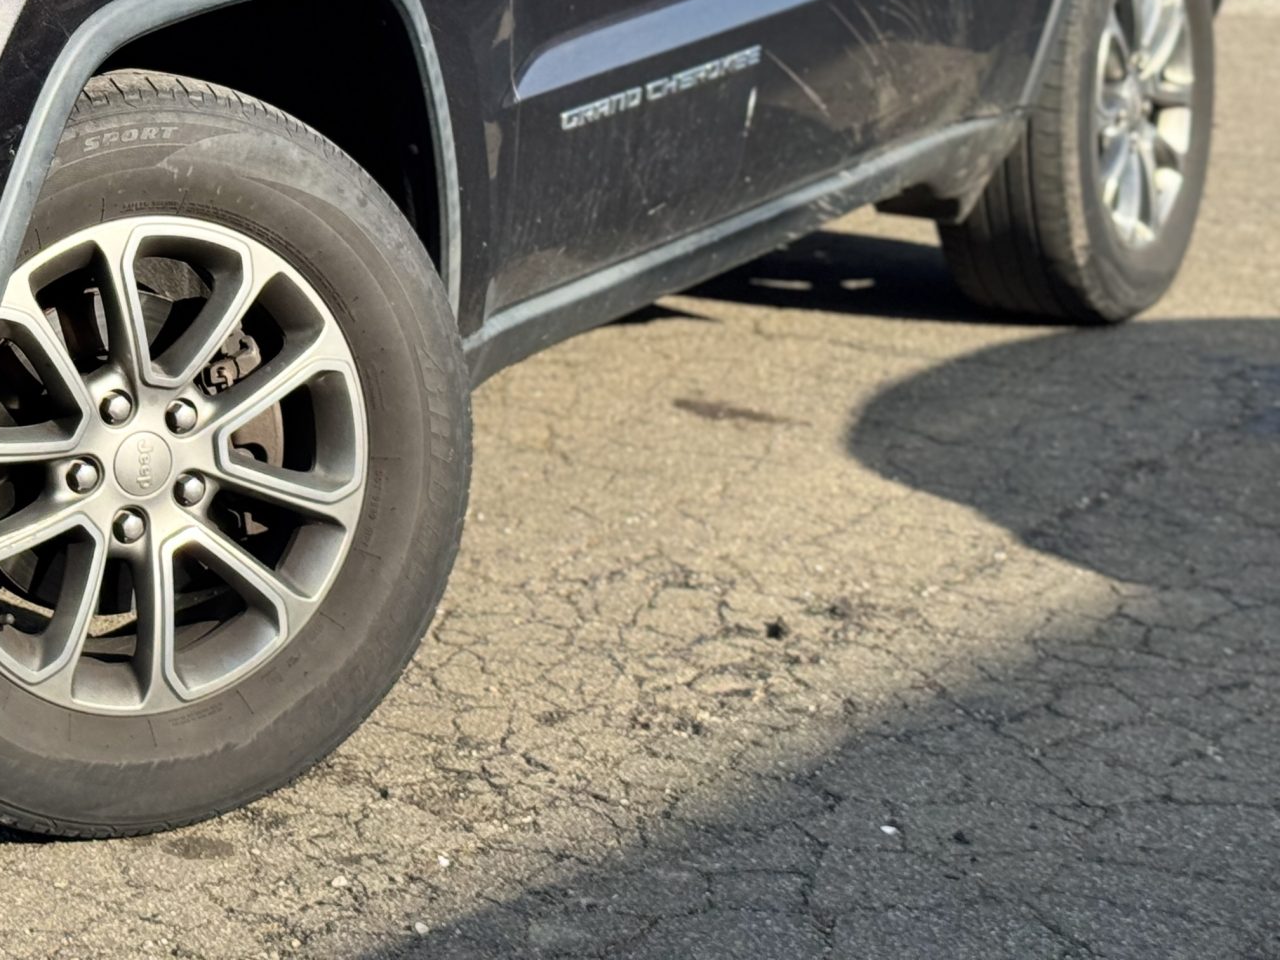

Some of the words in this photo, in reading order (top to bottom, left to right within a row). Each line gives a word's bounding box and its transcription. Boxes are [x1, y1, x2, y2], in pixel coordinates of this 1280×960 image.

[560, 87, 643, 130] GRAND
[646, 44, 762, 101] CHEROKEE
[83, 126, 179, 153] SPORT
[136, 439, 154, 490] Jeep
